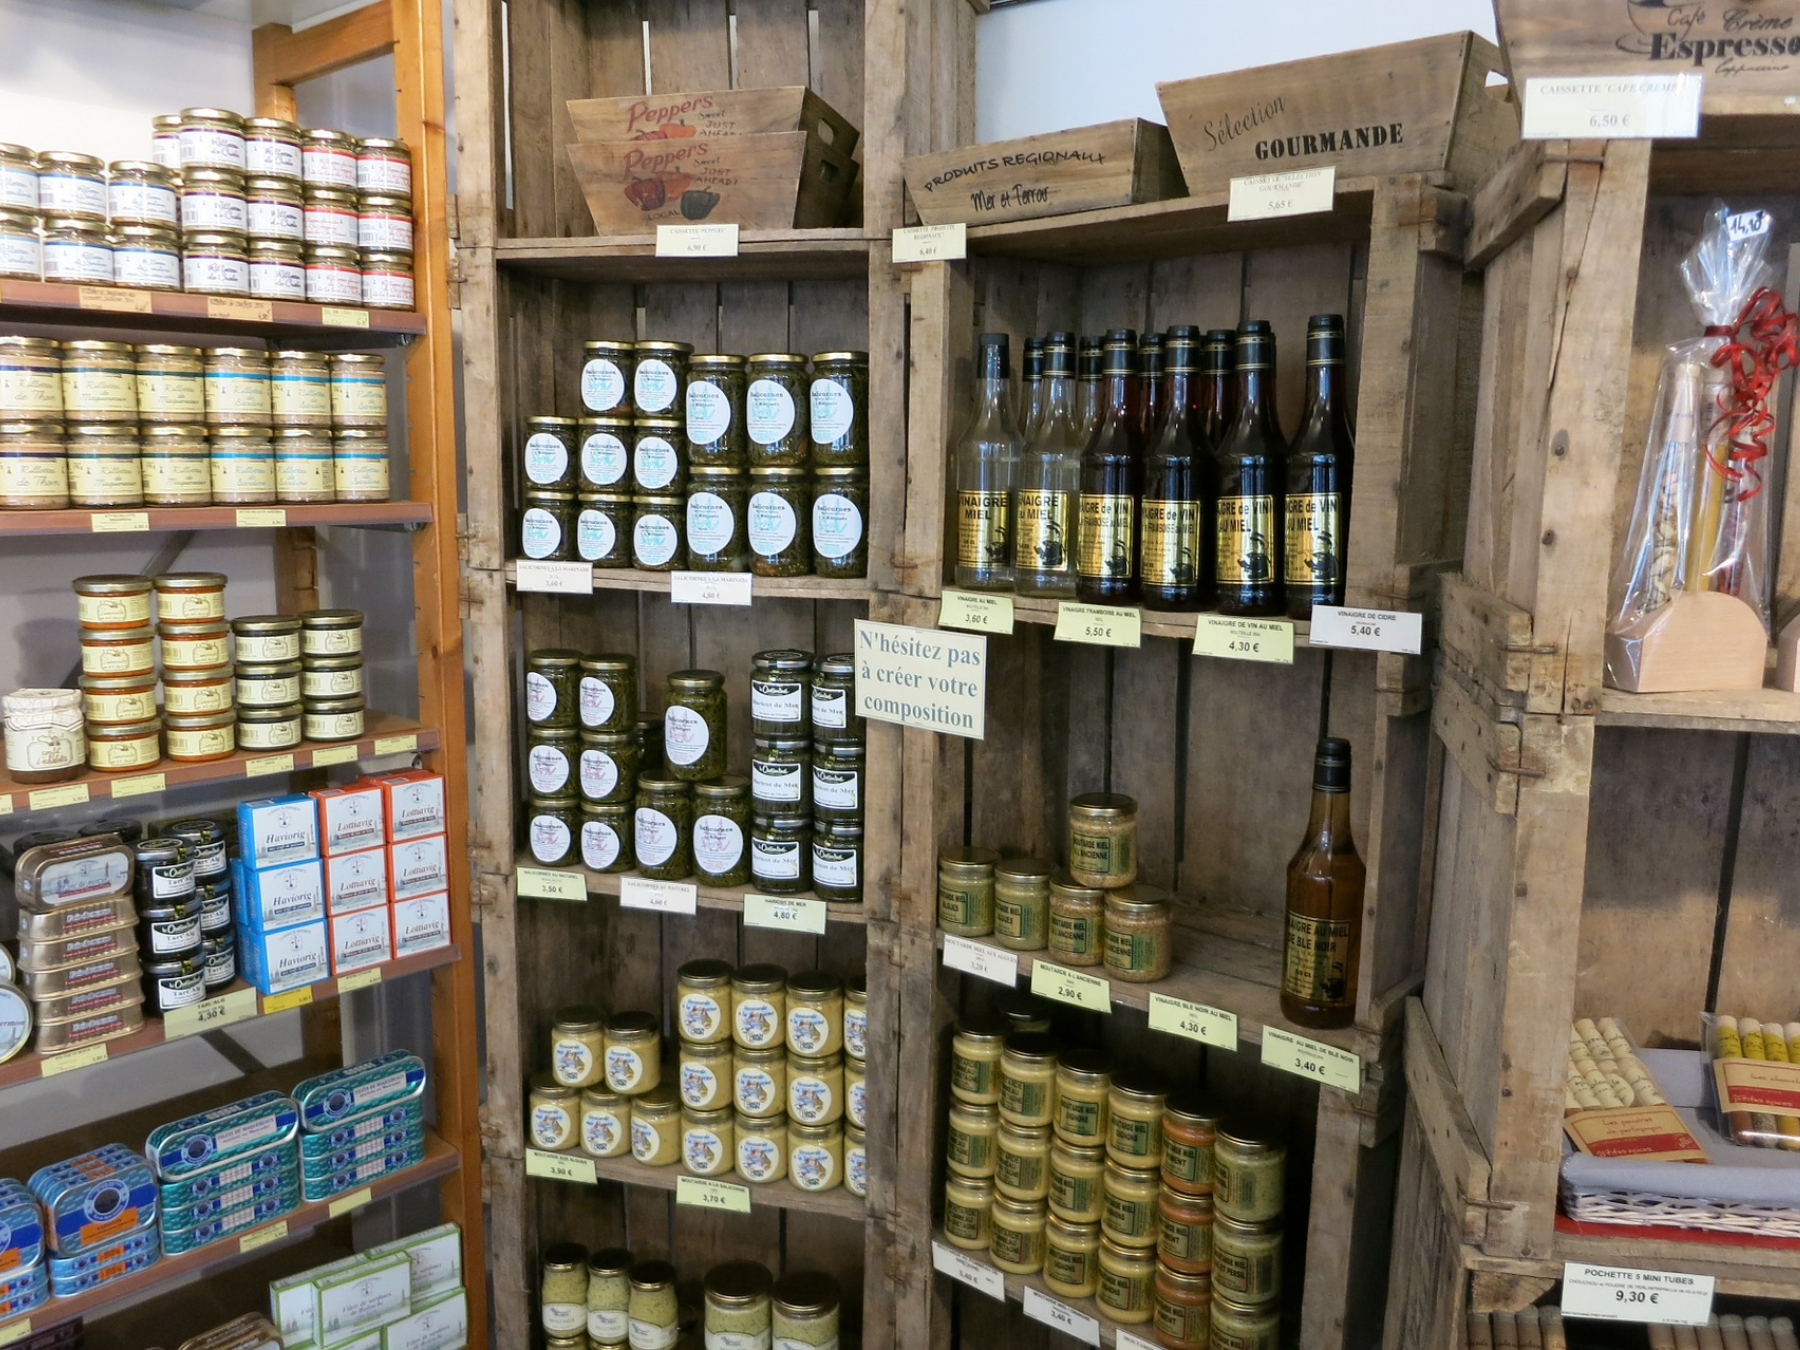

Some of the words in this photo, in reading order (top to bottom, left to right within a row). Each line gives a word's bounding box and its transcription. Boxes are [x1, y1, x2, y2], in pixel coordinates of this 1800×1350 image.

[1722, 9, 1793, 32] Crème
[1540, 83, 1599, 95] CAISSETTE
[627, 96, 713, 133] Peppers
[1589, 113, 1617, 128] 6,50
[1622, 113, 1631, 126] €
[1203, 96, 1287, 152] Sélection
[1255, 122, 1404, 161] GOURMANDE
[623, 143, 708, 181] Peppers
[924, 158, 999, 192] PRODUITS
[1002, 150, 1107, 167] REGIONAUX
[971, 190, 996, 212] Mer
[1268, 201, 1286, 211] 5,65
[1114, 502, 1129, 514] VIN
[1252, 500, 1269, 514] VIN
[1320, 499, 1337, 513] VIN
[965, 508, 992, 521] MIEL
[1027, 508, 1053, 521] MIEL
[1180, 508, 1195, 521] VIN
[1229, 518, 1251, 532] MIEL
[1299, 517, 1319, 531] MIEL
[957, 595, 978, 604] VINAIGRE
[986, 598, 998, 606] MIEL
[965, 614, 982, 624] 3,60
[982, 615, 988, 624] €
[1062, 606, 1086, 614] VINAIGRE
[1086, 607, 1115, 617] FRAMBOISE
[1123, 610, 1137, 619] MIEL
[1337, 610, 1366, 619] VINAIGRE
[1377, 613, 1396, 621] CIDRE
[1085, 626, 1103, 638] 5,50
[1105, 627, 1112, 638] €
[1208, 619, 1236, 628] VINAIGRE
[1237, 621, 1247, 629] DE
[1269, 624, 1283, 632] MIEL
[1351, 625, 1371, 636] 5,40
[1374, 626, 1381, 637] €
[858, 629, 941, 661] N'hésitez
[947, 647, 981, 667] pas
[1229, 640, 1250, 653] 4,30
[1252, 642, 1259, 653] €
[861, 660, 872, 680] à
[876, 665, 922, 690] créer
[928, 675, 978, 698] votre
[863, 694, 974, 731] composition
[524, 870, 551, 878] SALICORNES
[542, 885, 557, 893] 3,50
[628, 882, 659, 891] SALICORNES
[773, 911, 790, 920] 4,80
[792, 912, 797, 920] €
[1314, 923, 1326, 936] AU
[1328, 924, 1348, 937] MIEL
[946, 938, 972, 950] MOUTARDE
[973, 946, 985, 954] MIEL
[1297, 937, 1311, 949] BLE
[1314, 939, 1336, 953] NOIR
[1040, 964, 1067, 977] MOUTARDE
[1073, 973, 1101, 987] L'ANCIENNE
[1058, 987, 1076, 999] 2,90
[1077, 991, 1083, 1001] €
[198, 1010, 218, 1022] 4,30
[219, 1007, 226, 1016] €
[1155, 996, 1181, 1009] VINAIGRE
[1182, 1002, 1193, 1010] BLE
[1195, 1005, 1209, 1014] NOIR
[1219, 1011, 1232, 1022] MIEL
[1179, 1020, 1199, 1033] 4,30
[1201, 1026, 1207, 1036] €
[1268, 1030, 1293, 1043] VINAIGRE
[1304, 1042, 1317, 1051] MIEL
[1319, 1046, 1327, 1054] DE
[1328, 1049, 1339, 1058] BLE
[1340, 1053, 1354, 1063] NOIR
[1295, 1058, 1316, 1073] 3,40
[1319, 1065, 1325, 1076] €
[681, 1177, 706, 1187] MOUTARDE
[703, 1194, 719, 1203] 3,70
[720, 1196, 726, 1204] €
[1585, 1268, 1633, 1280] POCHETTE
[1643, 1274, 1662, 1283] MINI
[1664, 1275, 1694, 1285] TUBES
[1616, 1290, 1646, 1304] 9,30
[1649, 1292, 1659, 1305] €
